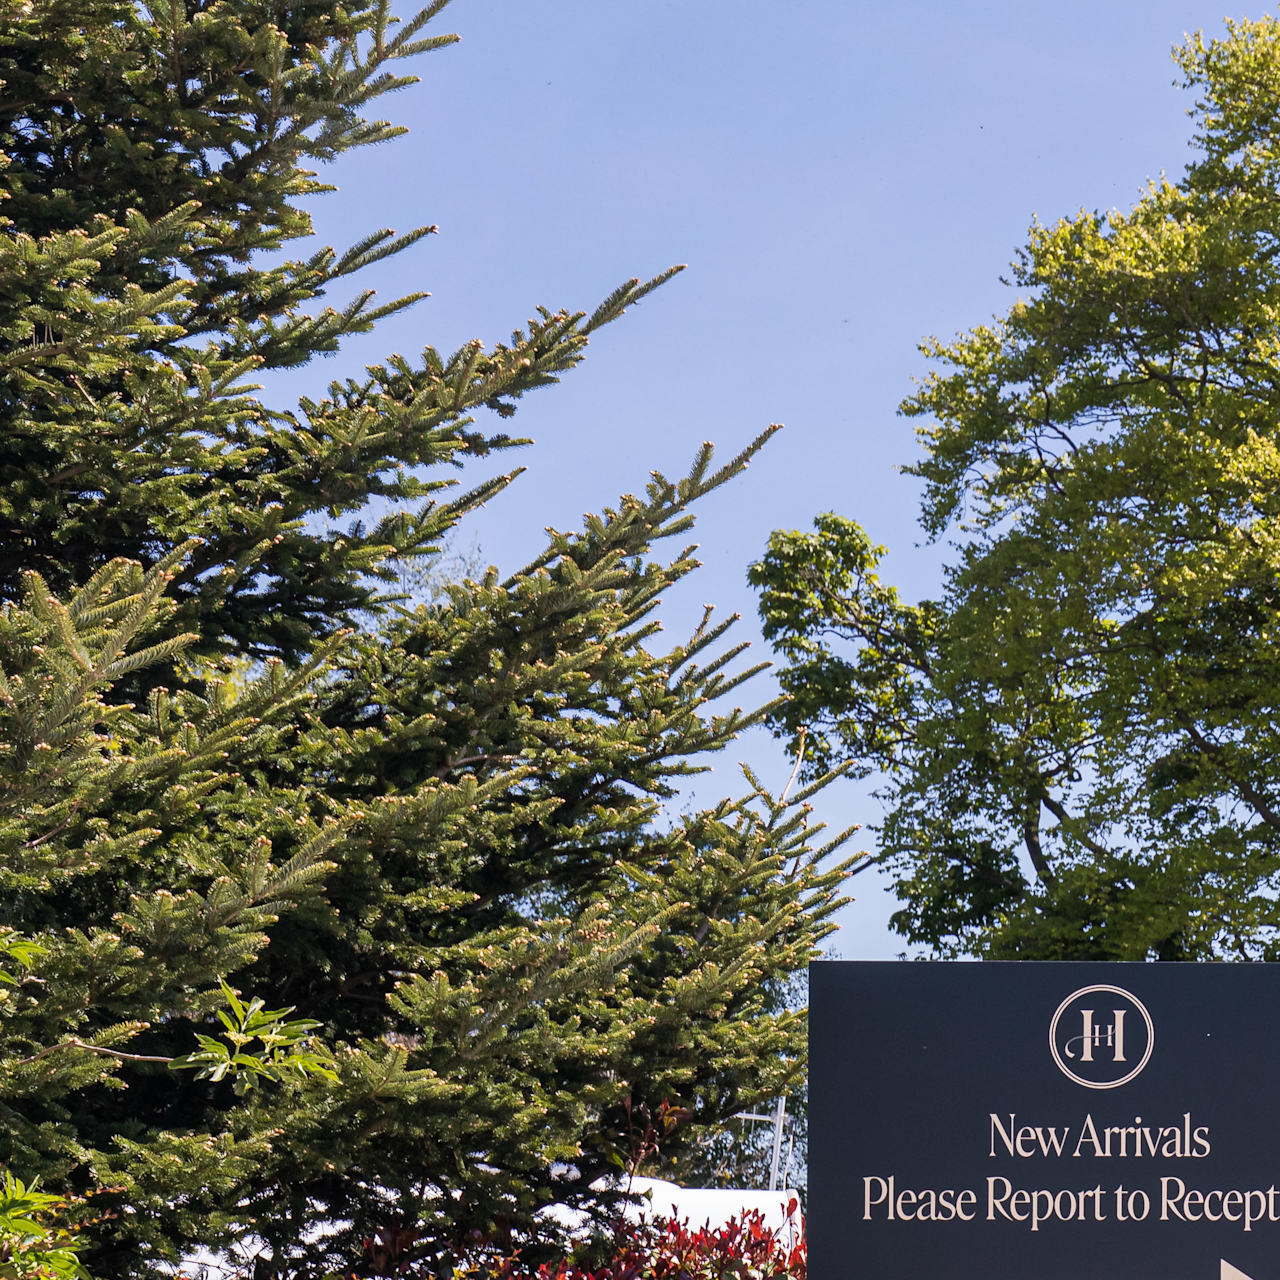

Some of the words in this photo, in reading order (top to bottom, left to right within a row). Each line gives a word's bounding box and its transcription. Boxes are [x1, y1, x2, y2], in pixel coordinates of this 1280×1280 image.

[989, 1113, 1070, 1158] New
[1072, 1112, 1211, 1158] Arrivals
[862, 1175, 977, 1221] Please
[985, 1176, 1107, 1232] Report
[1113, 1184, 1150, 1222] to
